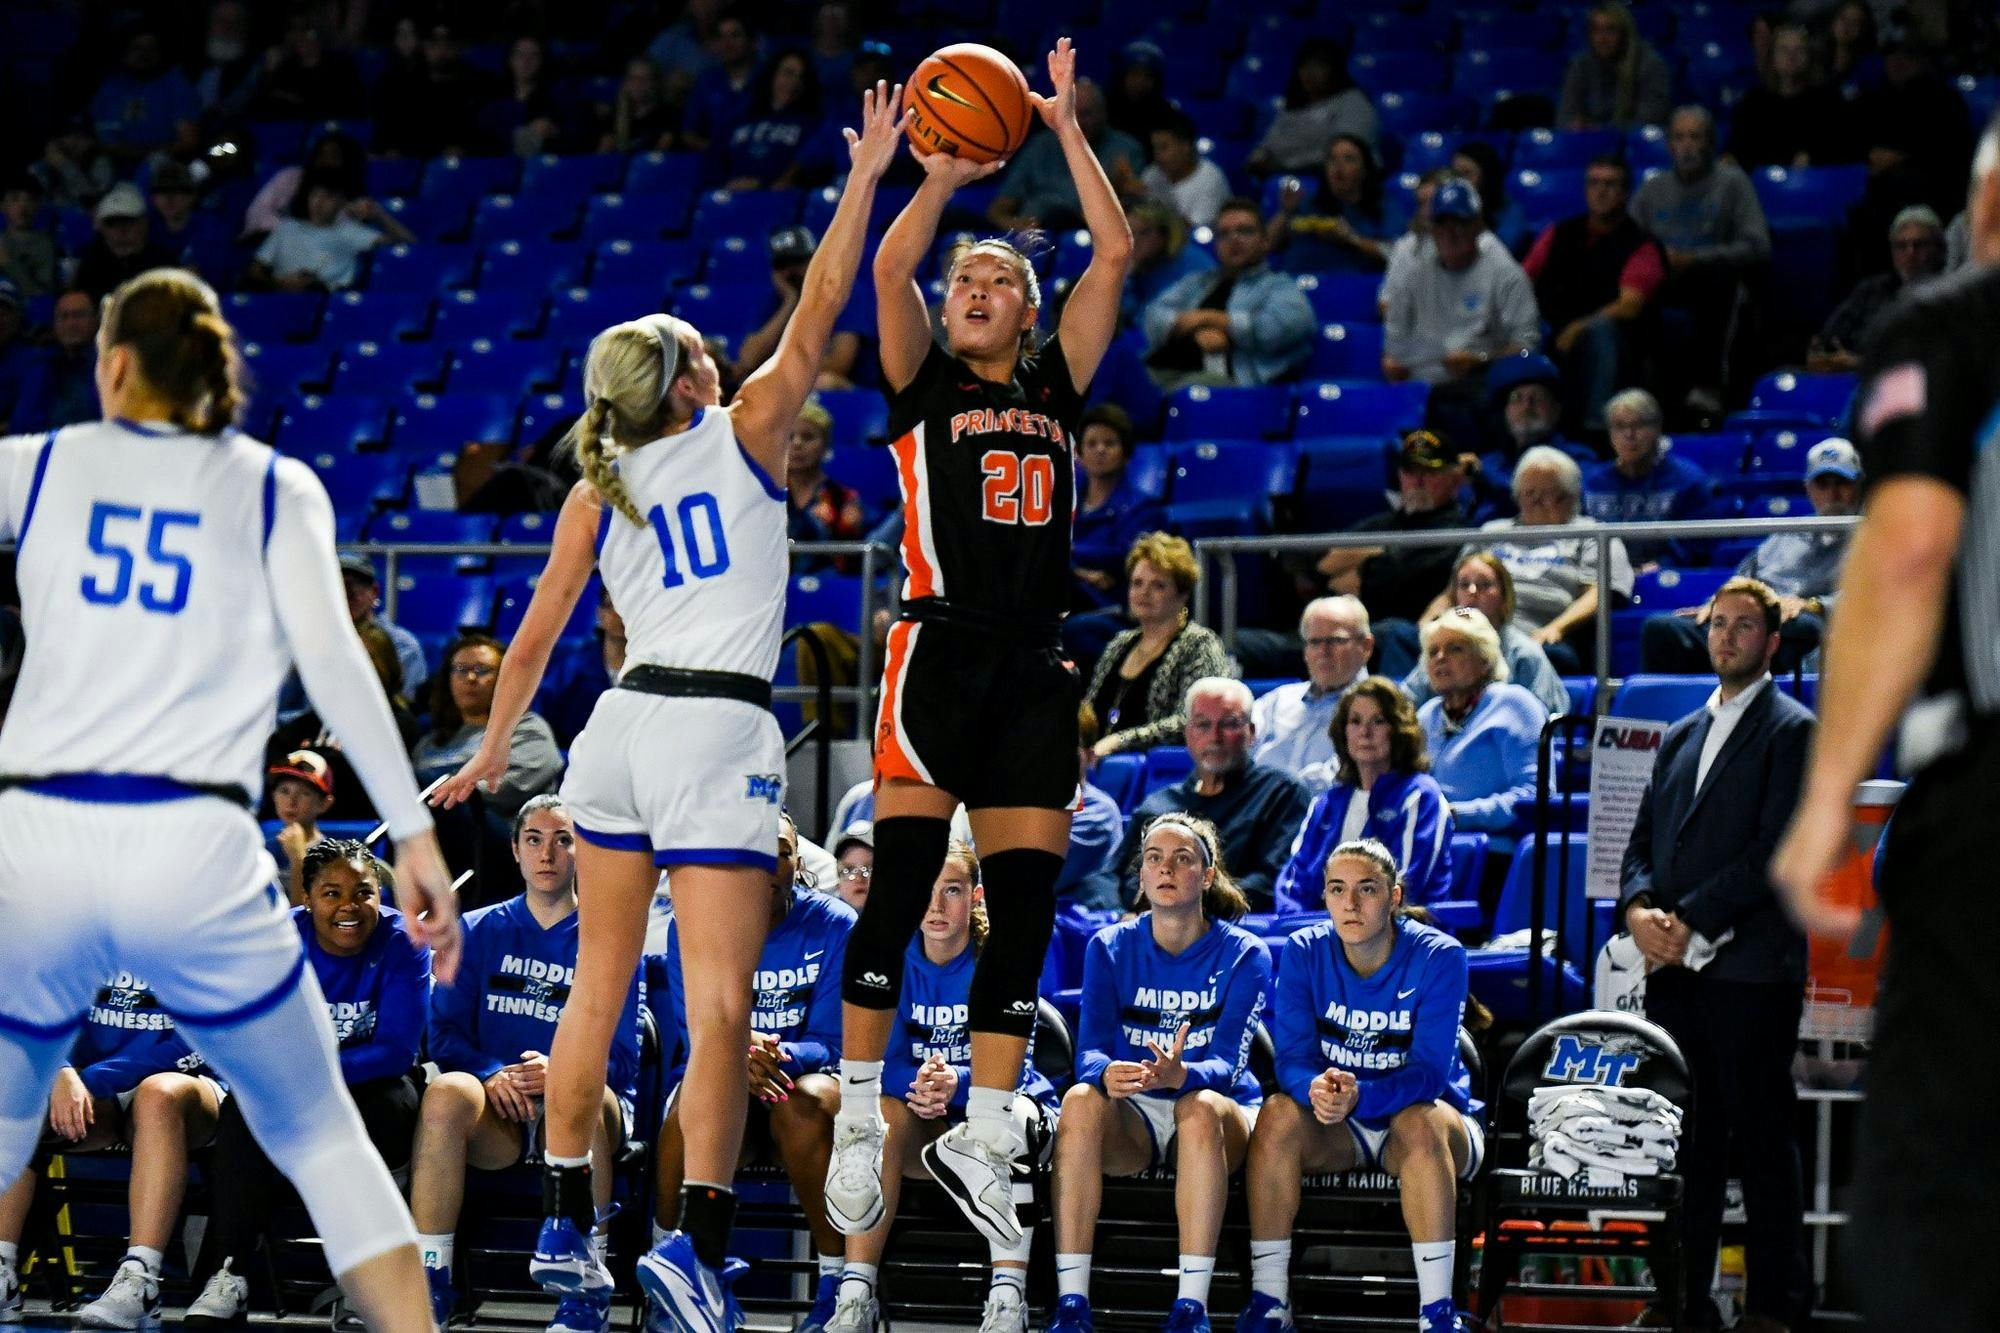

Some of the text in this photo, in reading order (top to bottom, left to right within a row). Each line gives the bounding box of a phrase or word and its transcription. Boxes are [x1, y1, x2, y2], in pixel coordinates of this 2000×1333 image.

[951, 408, 1067, 452] PRINCETO
[981, 450, 1055, 526] 20
[81, 501, 200, 614] 55
[647, 491, 730, 589] 10
[500, 954, 576, 986] MIDDL
[752, 963, 820, 990] IDDLE
[911, 1002, 969, 1026] MIDD
[1542, 1034, 1640, 1087] MT
[1520, 1176, 1562, 1197] BLUE
